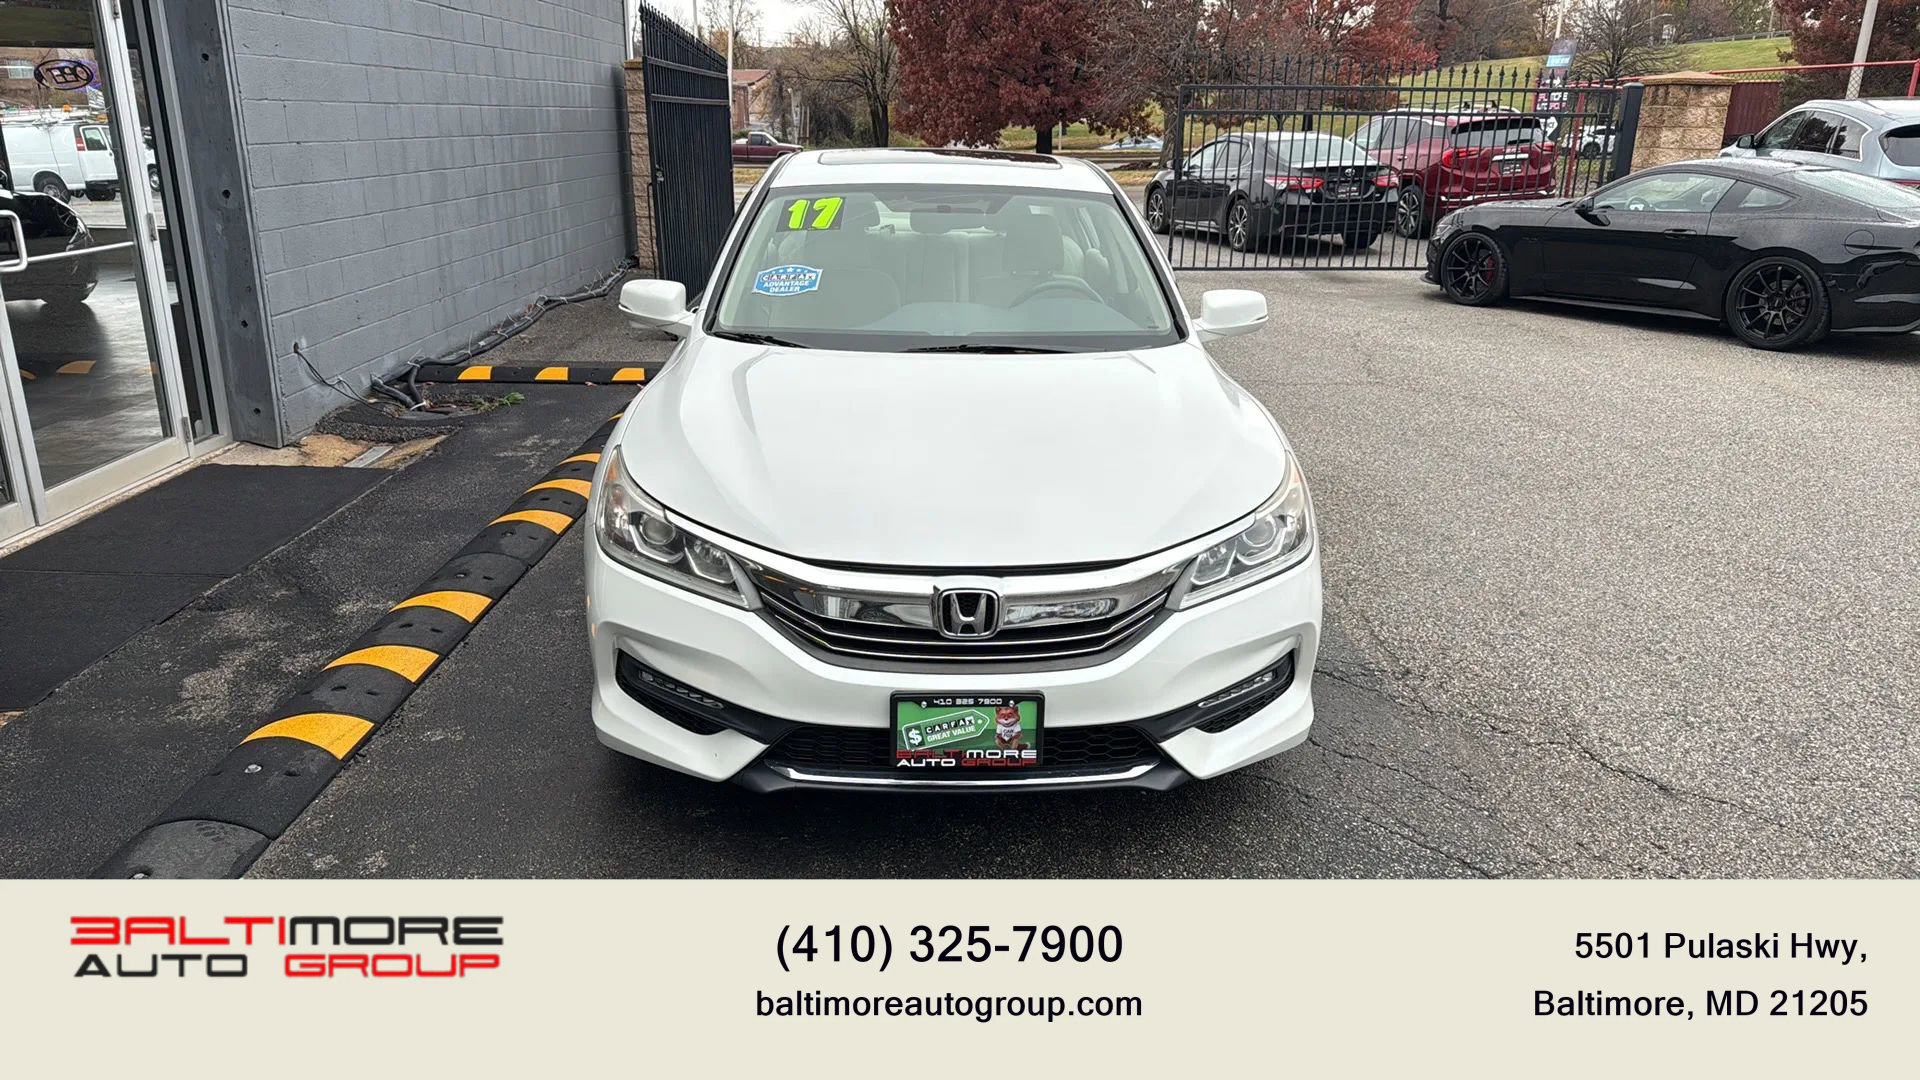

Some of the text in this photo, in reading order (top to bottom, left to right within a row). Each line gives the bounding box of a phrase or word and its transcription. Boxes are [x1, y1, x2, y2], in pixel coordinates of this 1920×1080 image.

[788, 197, 843, 230] 17
[762, 273, 816, 281] CARFAX
[763, 280, 809, 288] ADVANTAGE
[926, 716, 975, 733] CARFAX
[927, 725, 977, 743] GREAT VALUE
[896, 749, 1037, 758] BALTIMORE
[897, 758, 1037, 767] AUTO GROUP
